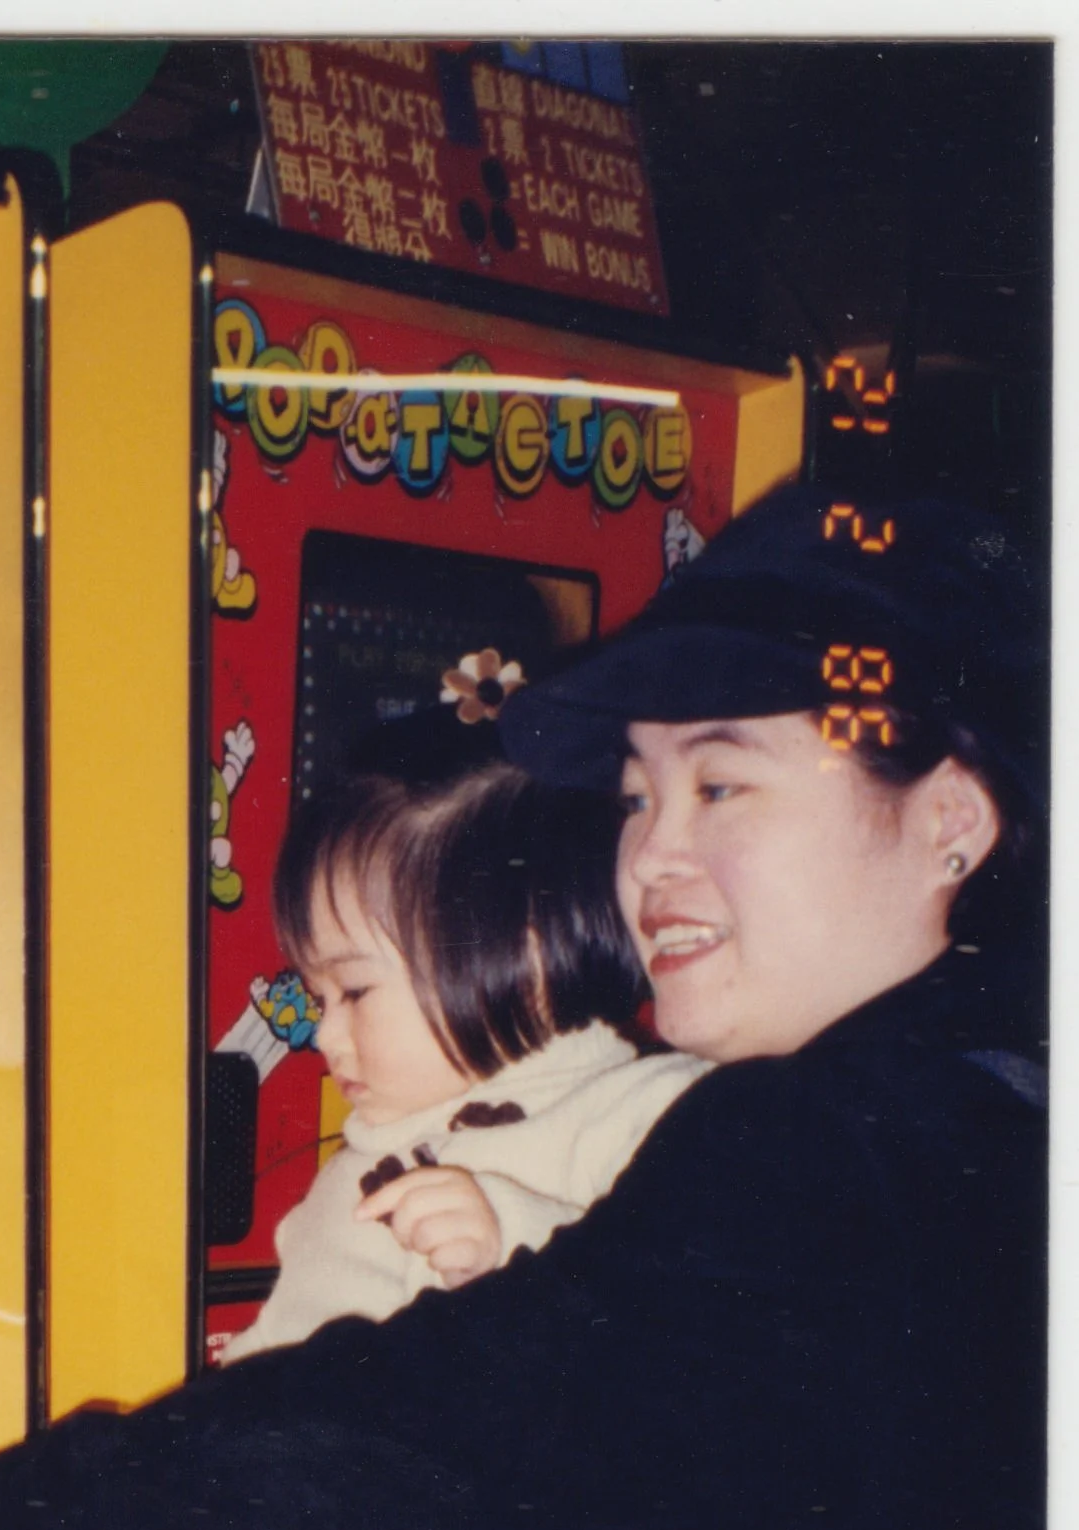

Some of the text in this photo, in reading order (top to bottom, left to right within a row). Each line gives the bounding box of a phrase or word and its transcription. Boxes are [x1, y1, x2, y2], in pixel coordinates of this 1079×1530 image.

[353, 75, 447, 138] TICKETS
[564, 141, 645, 198] TICKETS
[524, 174, 580, 221] EACH
[587, 192, 643, 238] GAME
[539, 230, 580, 275] WIN
[586, 242, 652, 293] BONUS
